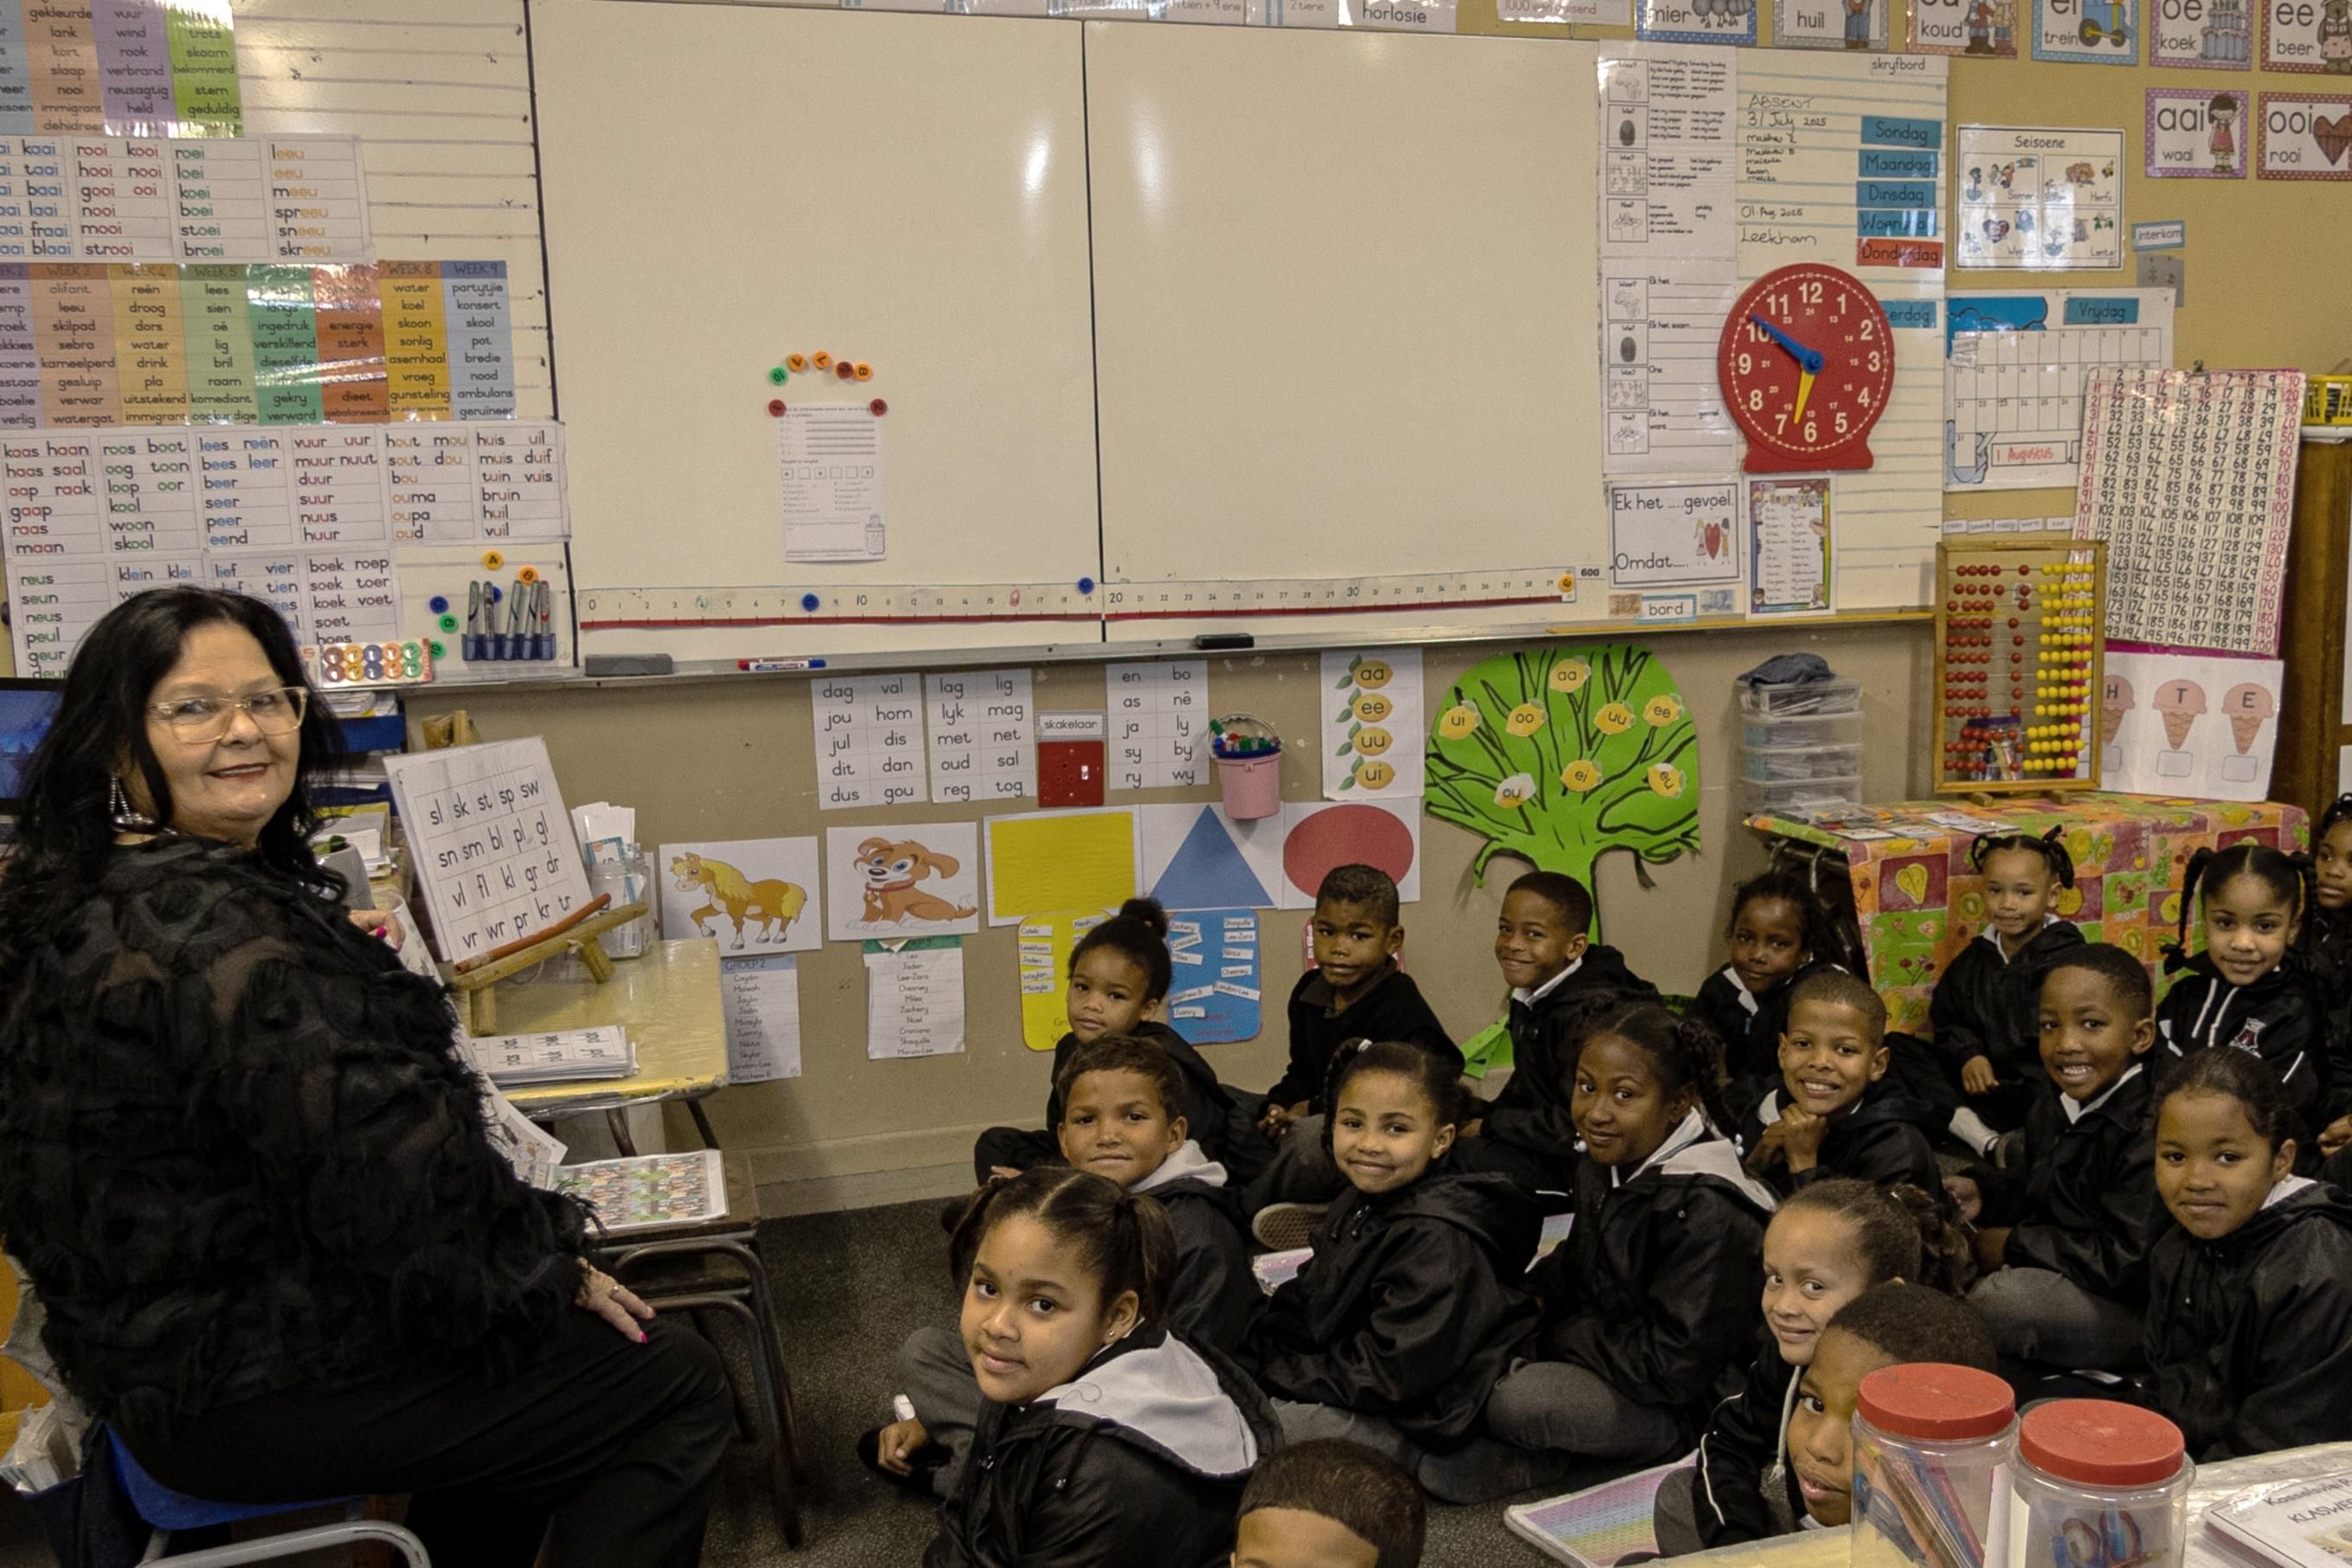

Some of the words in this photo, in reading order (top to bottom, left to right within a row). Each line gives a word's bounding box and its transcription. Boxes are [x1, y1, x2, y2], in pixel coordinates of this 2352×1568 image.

[114, 10, 144, 19] vuur
[1362, 1, 1427, 23] horlosie
[1797, 10, 1824, 29] huil
[2276, 3, 2314, 27] ee
[50, 28, 77, 38] lank
[117, 28, 146, 38] wind
[1921, 20, 1963, 38] koud
[2045, 29, 2078, 46] trein
[2161, 34, 2196, 52] koek
[187, 48, 228, 58] skaam
[2277, 38, 2314, 56] beer
[51, 66, 85, 79] slaap
[107, 66, 164, 76] verbrand
[1871, 58, 1925, 74] skryfbord
[195, 87, 228, 95] stem
[1748, 94, 1815, 109] ABSENT
[188, 104, 240, 118] geduldig
[2157, 103, 2206, 132] aai
[1748, 112, 1764, 126] 31
[1769, 112, 1795, 134] July
[1803, 118, 1827, 126] 2025
[2268, 106, 2314, 135] ooi
[1876, 121, 1928, 147] Sondag
[22, 141, 56, 156] kaai
[77, 144, 107, 156] rooi
[127, 141, 158, 157] kooi
[2015, 137, 2065, 149] Seisoene
[273, 145, 305, 160] leeu
[2162, 150, 2194, 162] waai
[2270, 148, 2302, 164] rooi
[1866, 155, 1931, 172] Maandag
[81, 184, 115, 202] gooi
[133, 185, 157, 196] ooi
[179, 183, 210, 199] koei
[1869, 185, 1924, 207] Dinsdag
[275, 205, 329, 223] spreeu
[31, 222, 68, 238] fraai
[81, 223, 122, 235] mooi
[1741, 227, 1817, 245] Leekham
[86, 243, 133, 256] strooi
[184, 245, 224, 257] broei
[280, 243, 331, 256] skreeu
[389, 264, 423, 274] WEEK
[426, 264, 432, 274] 8
[453, 263, 490, 273] WEEK
[491, 263, 498, 273] 9
[453, 284, 503, 297] partytjie
[1799, 283, 1822, 304] 12
[130, 304, 165, 317] droog
[1767, 295, 1789, 315] 11
[1837, 294, 1846, 314] 1
[2079, 304, 2125, 324] Vrydag
[53, 321, 95, 335] skilpad
[466, 318, 494, 327] skool
[138, 359, 168, 368] drink
[215, 358, 233, 368] bril
[1738, 354, 1751, 374] 9
[1867, 352, 1880, 371] 3
[402, 373, 434, 384] vroeg
[458, 389, 513, 398] ambulans
[1858, 389, 1869, 407] 4
[54, 414, 115, 428] watergat
[1775, 414, 1787, 434] 7
[478, 433, 505, 446] huis
[529, 431, 545, 445] uil
[1804, 422, 1816, 441] 6
[104, 445, 135, 455] roos
[147, 439, 186, 453] boot
[200, 438, 228, 451] lees
[244, 435, 279, 448] reën
[386, 434, 421, 447] hout
[434, 437, 467, 447] mou
[4, 444, 39, 458] kaas
[47, 441, 89, 455] haan
[2008, 447, 2053, 462] Augustus
[2170, 441, 2185, 452] 55
[2191, 441, 2206, 453] 56
[2256, 445, 2271, 456] 59
[2190, 455, 2204, 466] 66
[2255, 459, 2269, 469] 69
[482, 488, 520, 502] bruin
[1615, 494, 1632, 511] Ek
[1636, 492, 1662, 510] het
[10, 506, 52, 521] gaap
[394, 511, 430, 526] oupa
[207, 516, 242, 532] peer
[304, 528, 340, 541] huur
[2157, 536, 2174, 547] 125
[16, 543, 64, 555] maan
[114, 535, 154, 550] skool
[309, 558, 344, 573] boek
[355, 558, 389, 574] roep
[21, 575, 55, 585] reus
[2173, 578, 2190, 589] 156
[588, 599, 595, 609] 0
[857, 595, 866, 606] 10
[1109, 593, 1122, 602] 20
[1347, 587, 1359, 597] 30
[1649, 601, 1683, 615] bord
[2232, 637, 2249, 649] 199
[2252, 639, 2272, 650] 200
[1360, 667, 1385, 680] aa
[823, 683, 853, 704] dag
[881, 678, 903, 694] val
[2107, 684, 2117, 699] H
[2176, 688, 2187, 704] T
[1123, 697, 1141, 708] as
[1173, 691, 1191, 705] nê
[2243, 692, 2254, 708] E
[942, 703, 965, 725] lyk
[988, 705, 1024, 721] mag
[1361, 701, 1385, 714] ee
[825, 711, 851, 731] jou
[876, 705, 913, 721] hom
[1044, 719, 1097, 729] skakelaar
[1515, 712, 1534, 724] oo
[1122, 722, 1139, 739] ja
[1176, 716, 1189, 736] ly
[1361, 735, 1385, 748] uu
[941, 754, 970, 770] oud
[997, 750, 1019, 767] sal
[1365, 766, 1382, 781] ui
[1574, 768, 1587, 782] ei
[1659, 770, 1674, 790] eu
[831, 787, 859, 802] dus
[884, 785, 914, 804] gou
[944, 785, 970, 801] reg
[996, 781, 1024, 797] tog
[1502, 787, 1521, 799] ou
[431, 800, 443, 826] sl
[453, 794, 469, 819] sk
[478, 794, 493, 812] st
[499, 788, 515, 813] sp
[521, 781, 540, 798] sw
[439, 849, 459, 867] sn
[462, 839, 485, 860] sm
[488, 825, 504, 850] bl
[513, 819, 526, 853] pl
[537, 812, 549, 845] gl
[452, 881, 467, 908] vl
[477, 874, 490, 899] fl
[501, 865, 516, 890] kl
[525, 865, 538, 891] gr
[547, 851, 559, 874] dr
[726, 960, 759, 971] GROEP
